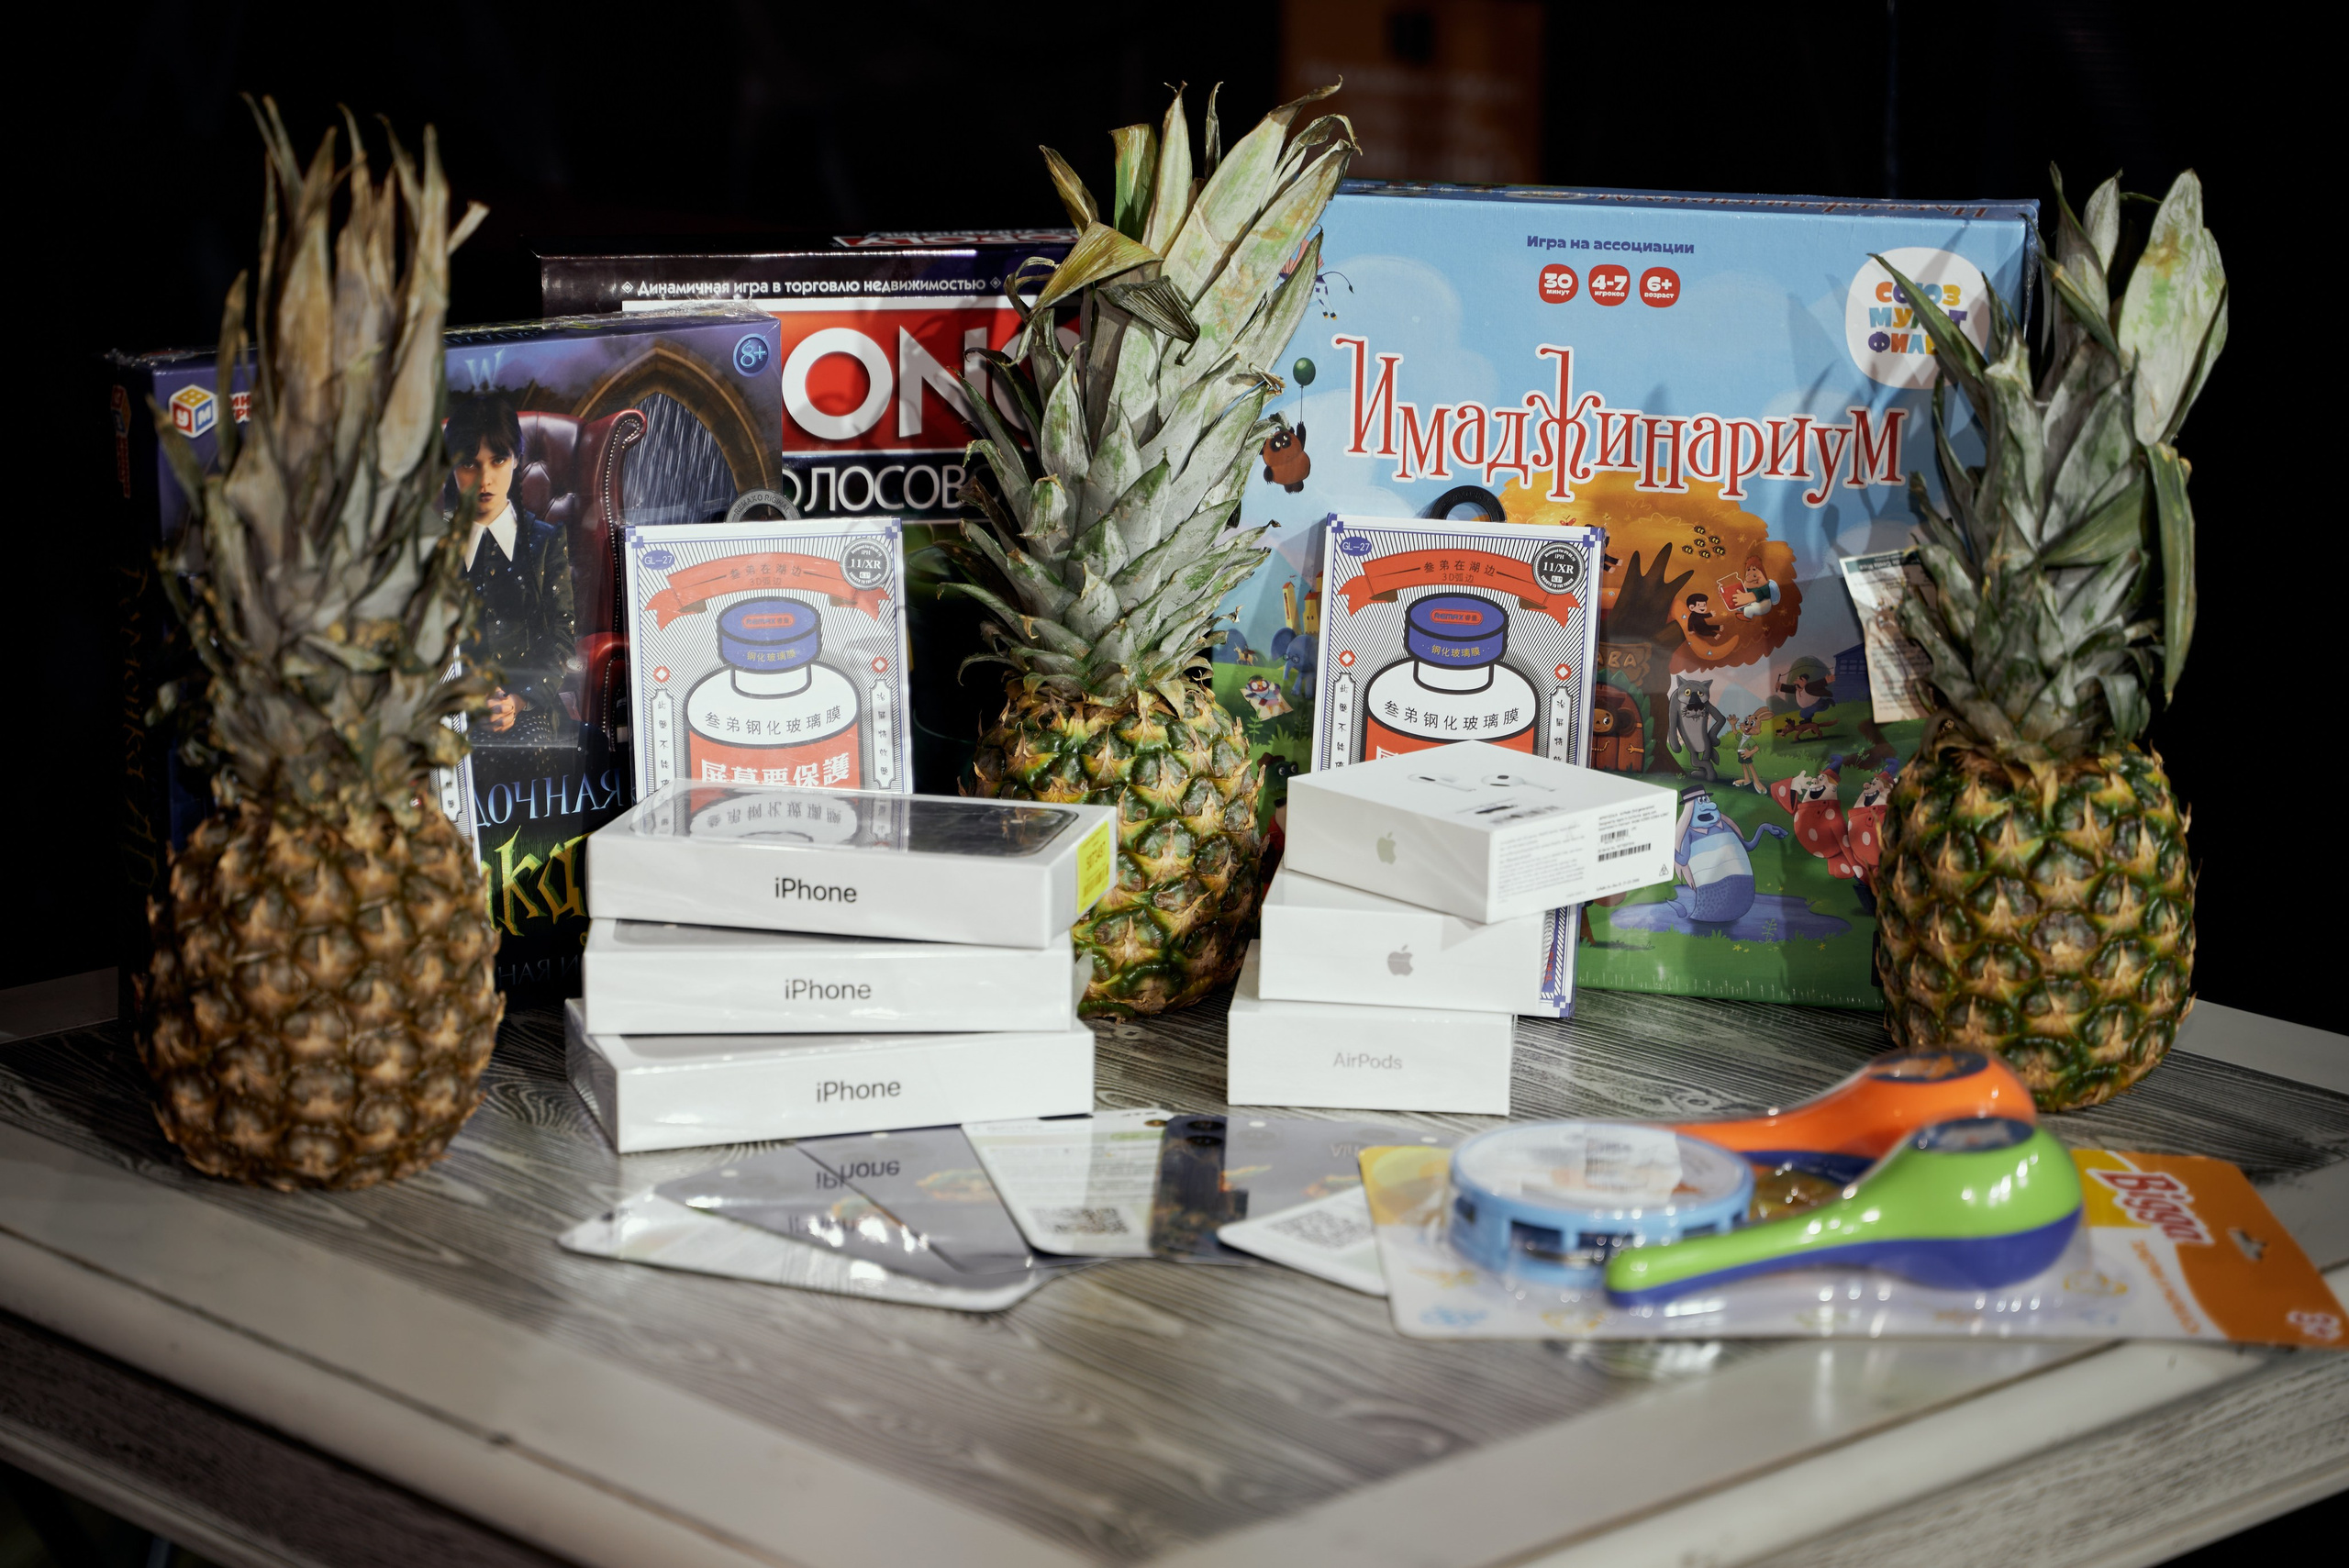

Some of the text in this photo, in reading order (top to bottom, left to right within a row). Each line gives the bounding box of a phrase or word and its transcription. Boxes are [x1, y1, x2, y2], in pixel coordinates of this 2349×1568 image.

[1527, 235, 1695, 254] Игра на ассоциации
[637, 279, 985, 296] Динамичная игра в торговлю недвижимостью
[1543, 272, 1573, 289] 30
[1591, 274, 1628, 291] 4-7
[1646, 276, 1673, 292] 6+
[1869, 306, 1968, 329] МУТ
[740, 339, 768, 368] 8+
[465, 348, 505, 392] W
[1334, 337, 1907, 506] Имаджинариум
[851, 558, 882, 570] 11/XR
[1423, 560, 1496, 577] 叁弟在湖边
[1542, 562, 1575, 574] 11/XR
[1431, 644, 1482, 658] 钢化玻璃膜
[704, 705, 842, 735] 叁弟钢化玻璃膜
[1384, 699, 1520, 731] 叁弟钢化玻璃膜
[774, 876, 858, 904] iPhone
[785, 978, 872, 1000] iPhone
[1332, 1051, 1403, 1070] AirPods
[817, 1080, 902, 1104] iPhone
